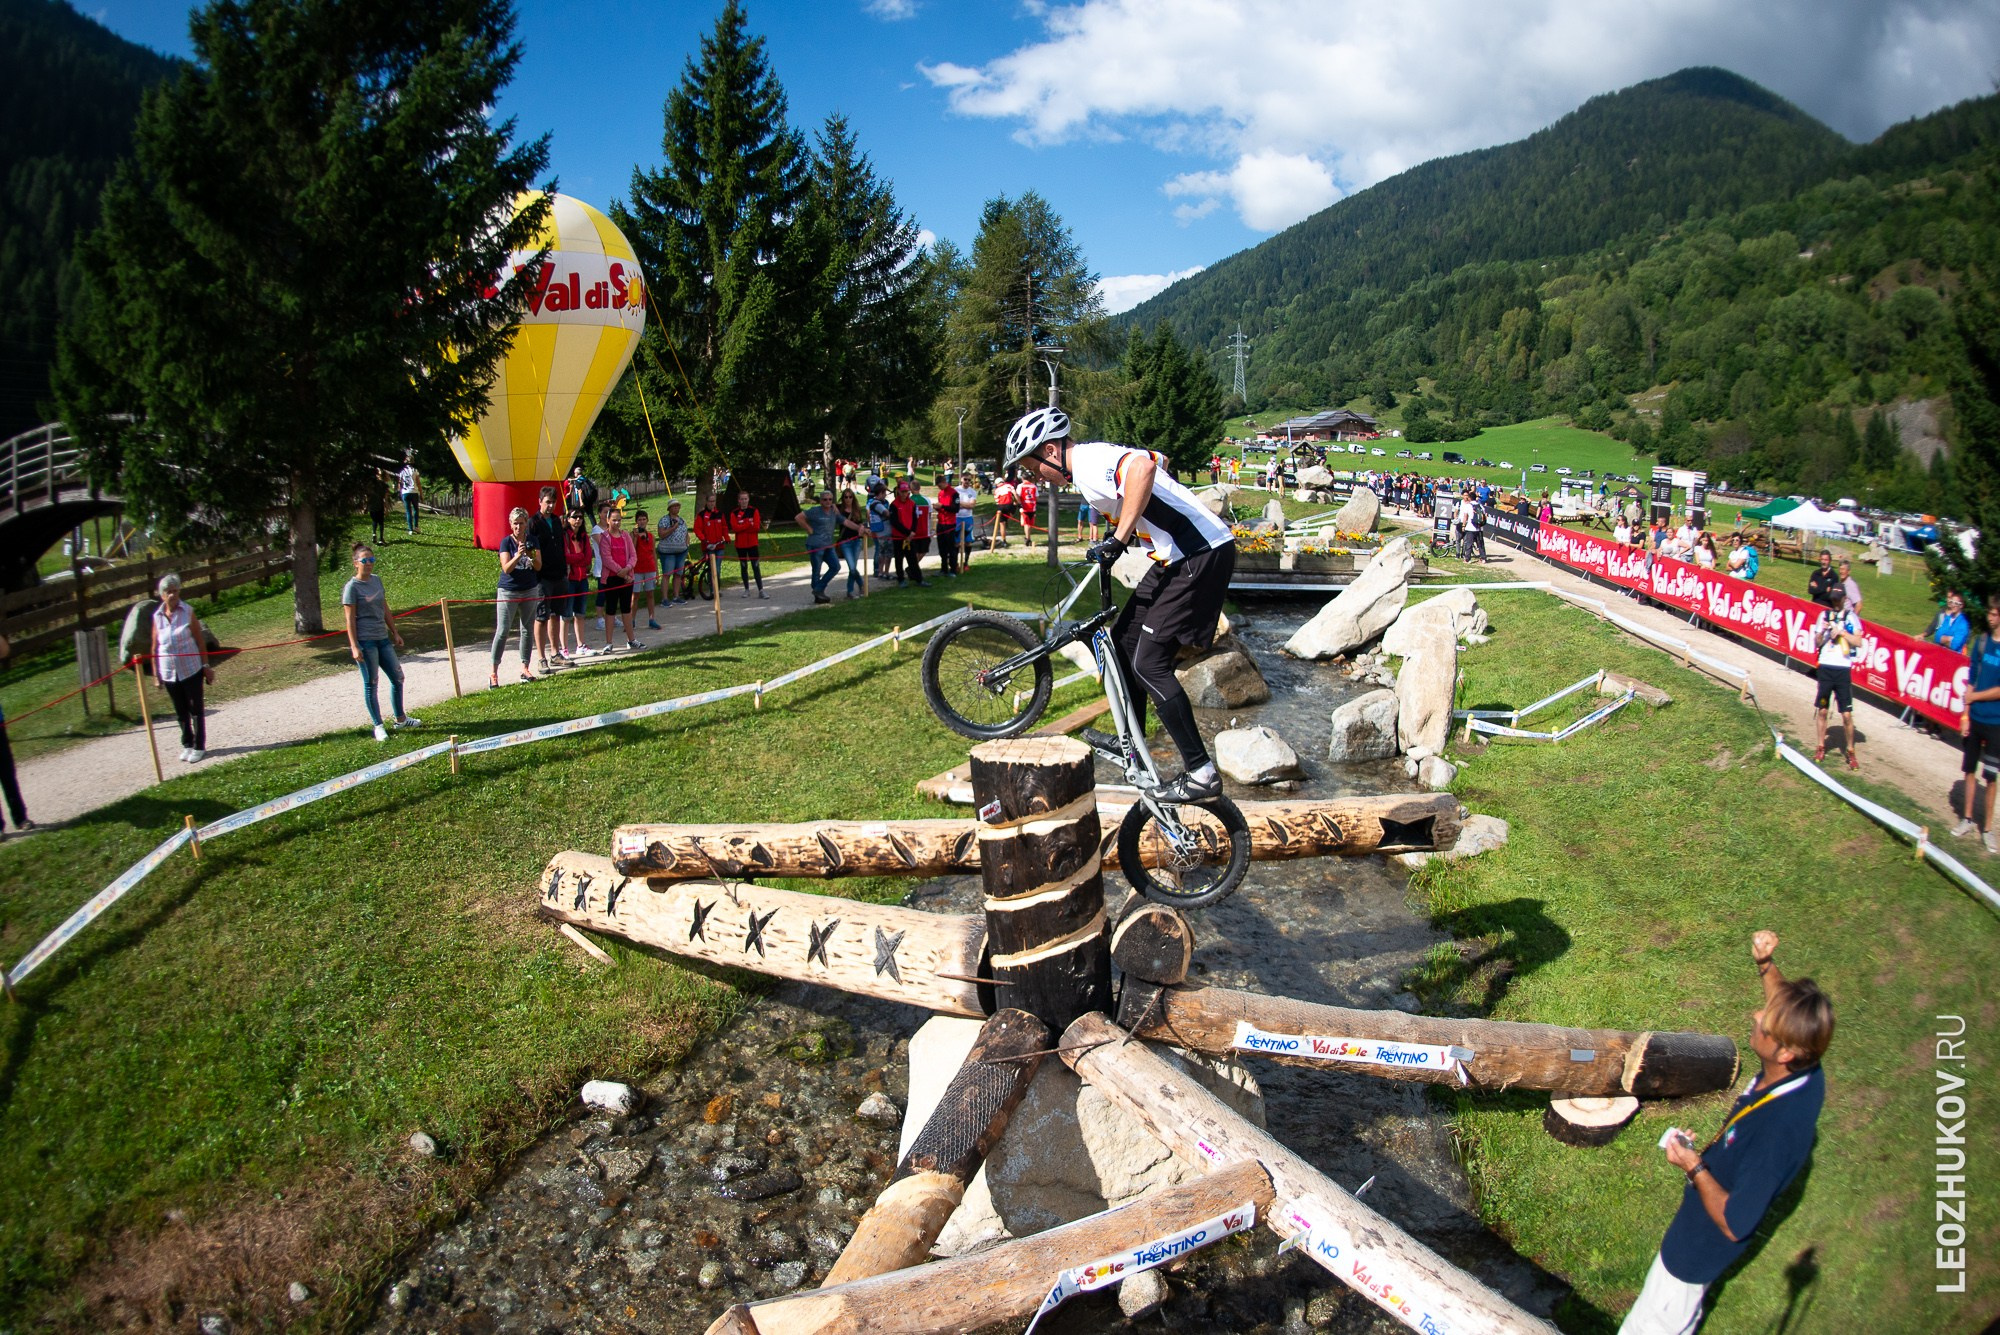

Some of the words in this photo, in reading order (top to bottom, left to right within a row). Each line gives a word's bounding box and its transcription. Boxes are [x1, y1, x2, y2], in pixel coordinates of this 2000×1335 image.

[513, 262, 581, 317] Val
[585, 281, 609, 309] di
[1440, 505, 1448, 517] 2
[1607, 550, 1621, 577] Val
[1651, 563, 1668, 594] Val
[1667, 578, 1677, 595] di
[1675, 567, 1705, 601] Sole
[1706, 581, 1731, 616] Val
[1729, 601, 1742, 621] di
[1741, 589, 1782, 630] Sole
[1785, 609, 1817, 653] Val
[1895, 649, 1934, 701] Val
[1930, 681, 1951, 709] di
[1245, 1035, 1299, 1051] RENTINO
[1312, 1039, 1331, 1055] Val
[1330, 1046, 1339, 1055] di
[1339, 1042, 1367, 1057] Sole
[1376, 1046, 1428, 1065] TRENTINO
[1084, 1262, 1125, 1284] Sole
[1133, 1231, 1207, 1266] TRENTINO
[1223, 1213, 1244, 1231] Val
[1352, 1259, 1371, 1285] Val
[1369, 1281, 1381, 1293] di
[1379, 1284, 1411, 1317] Sole
